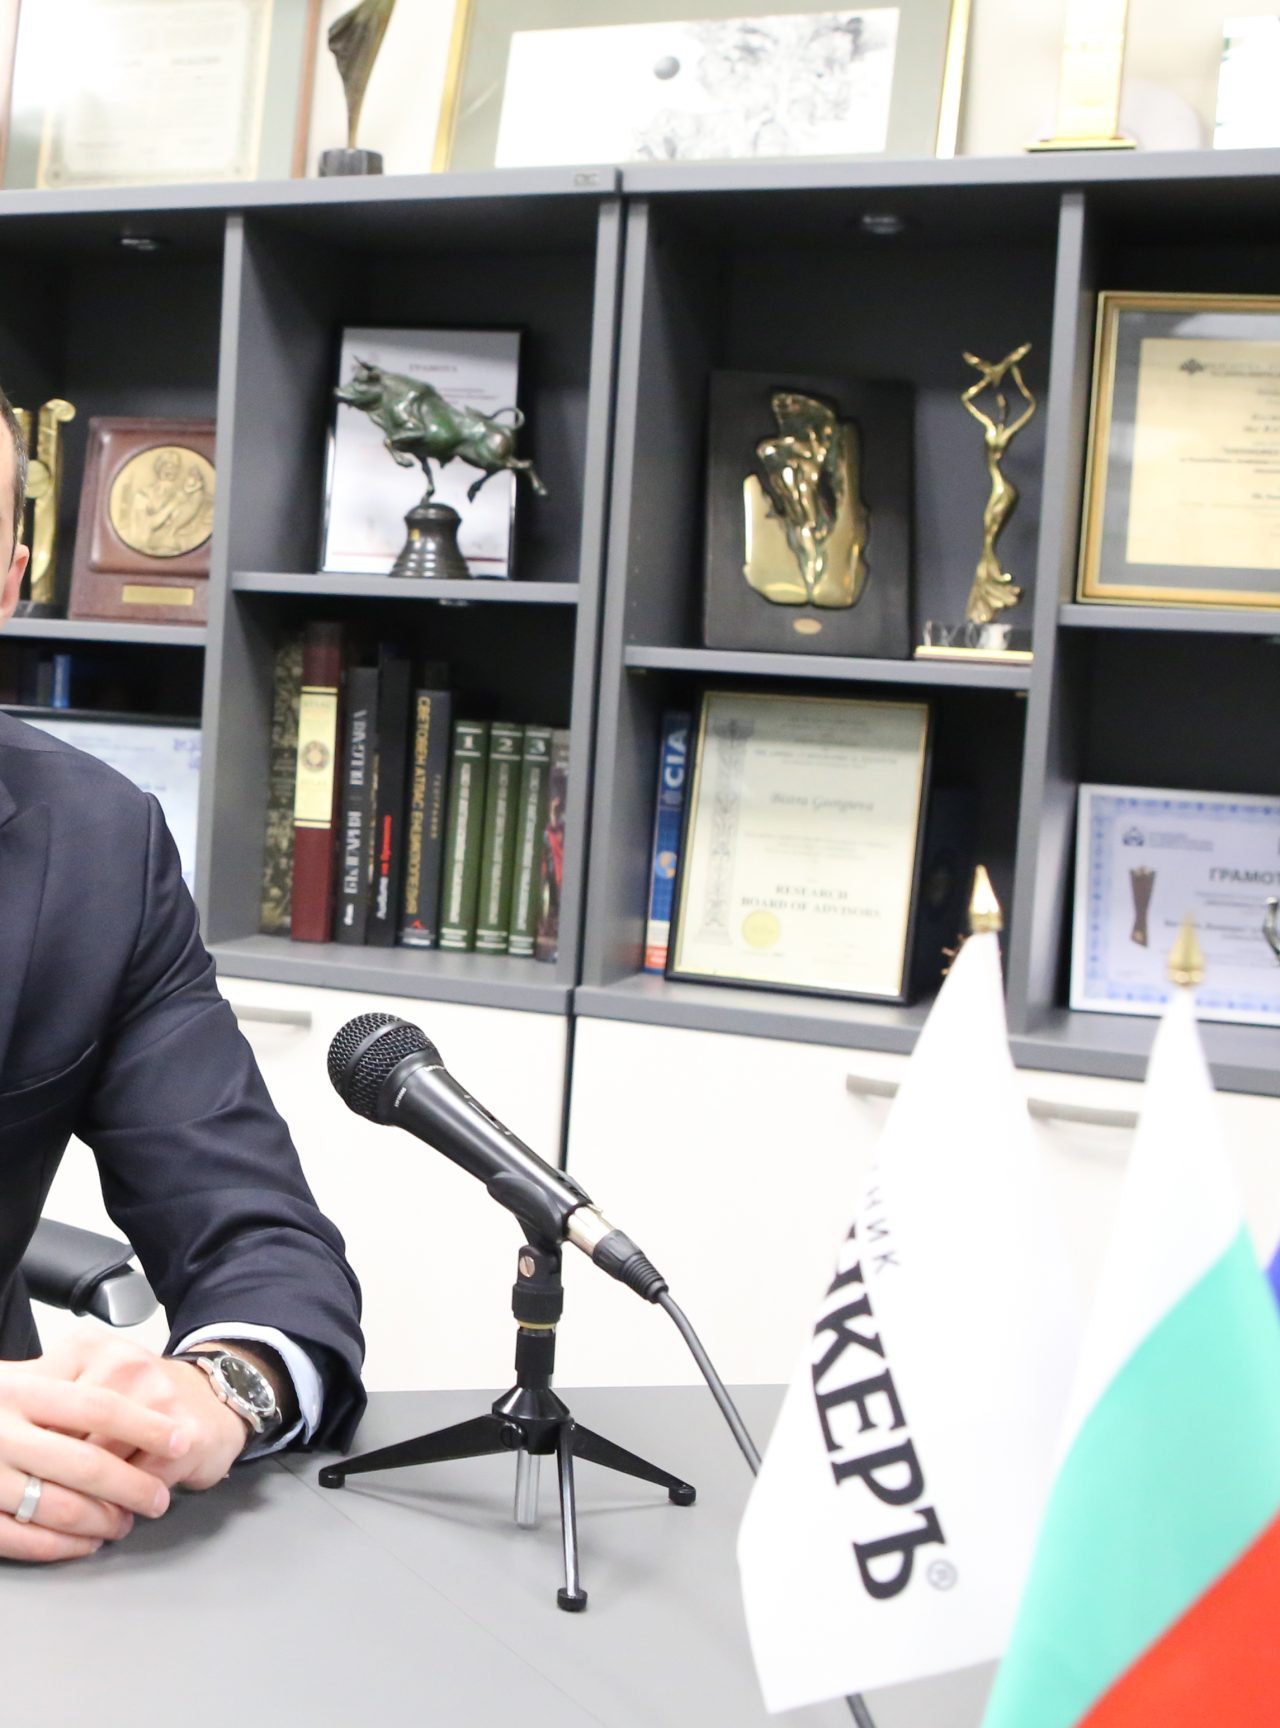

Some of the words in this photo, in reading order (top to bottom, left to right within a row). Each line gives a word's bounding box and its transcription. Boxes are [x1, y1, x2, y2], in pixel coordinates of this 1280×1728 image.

[463, 735, 474, 749] 1
[498, 737, 513, 752] 2
[529, 738, 546, 754] 3
[663, 728, 687, 788] CIA
[775, 883, 848, 900] RESEARCH
[740, 896, 788, 911] BOARD
